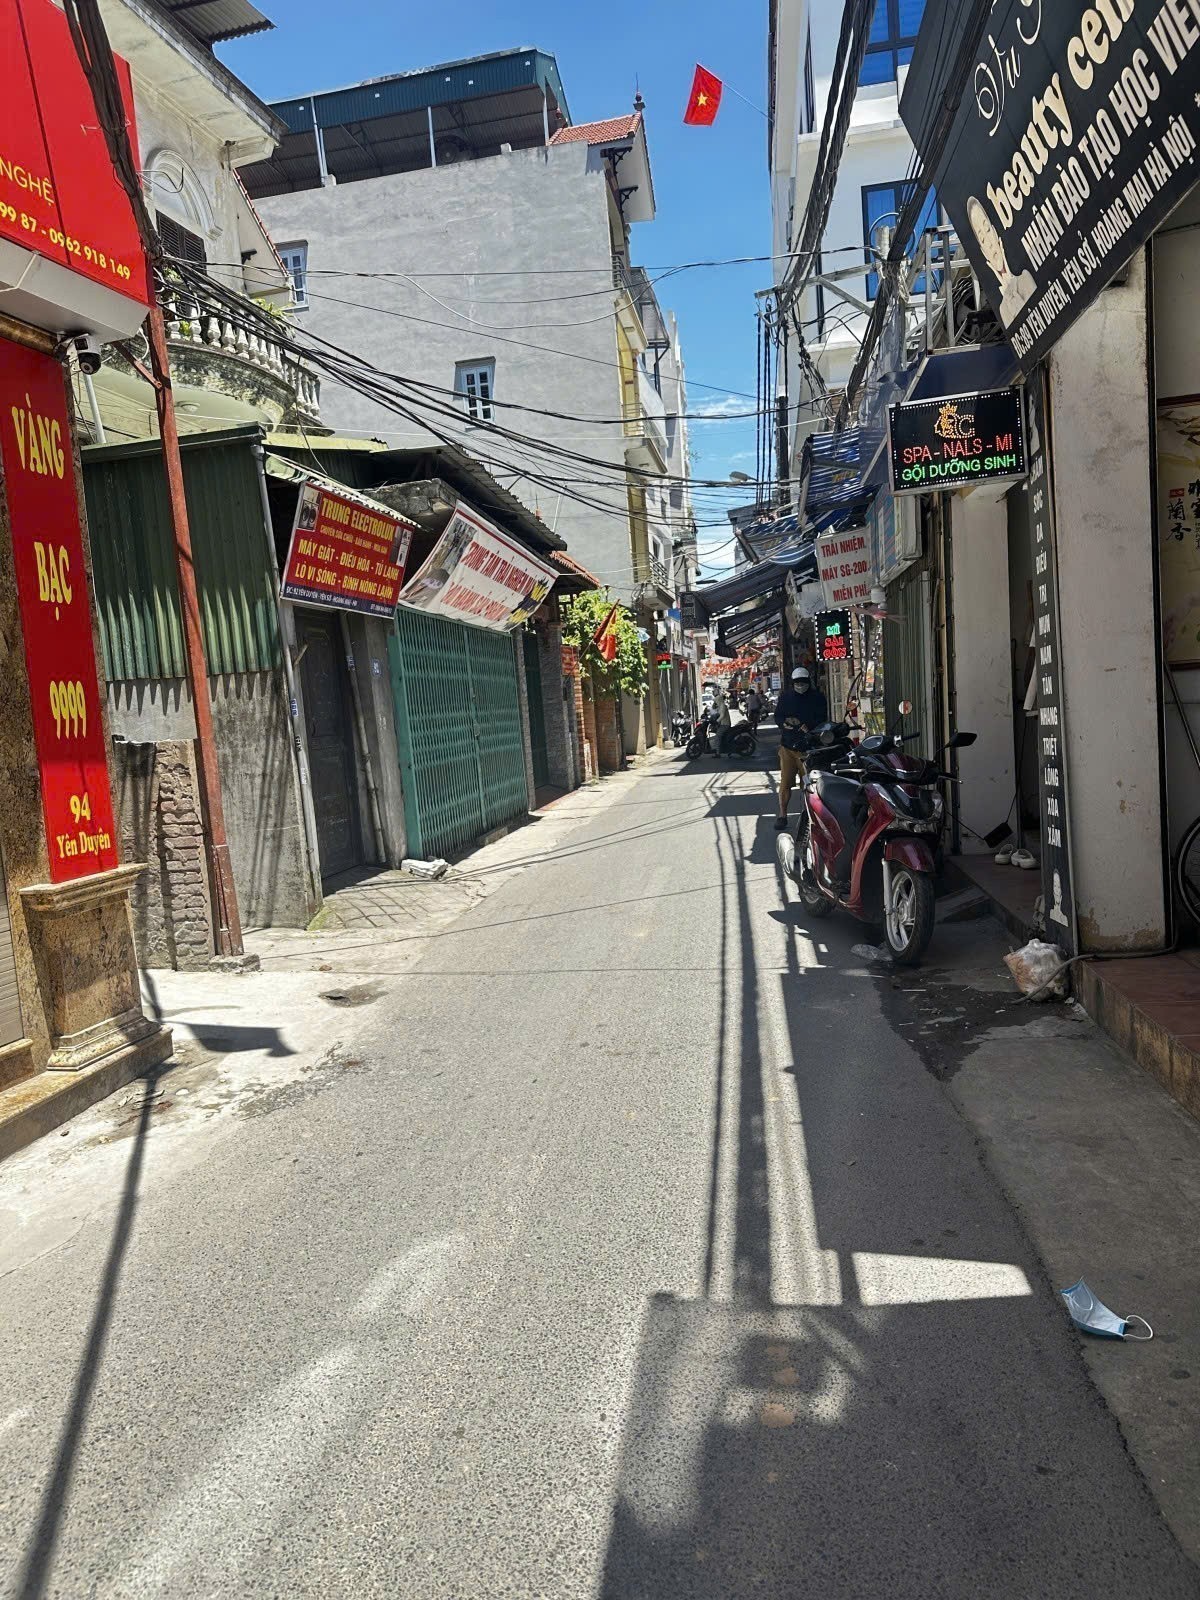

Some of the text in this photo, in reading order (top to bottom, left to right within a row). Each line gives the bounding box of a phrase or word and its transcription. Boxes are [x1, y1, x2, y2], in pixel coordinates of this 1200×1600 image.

[986, 72, 1073, 230] beauty
[1021, 197, 1065, 273] NHẬN
[1051, 156, 1091, 226] ĐÀO
[1078, 108, 1121, 182] TẠO
[1108, 48, 1161, 137] HỌC
[1026, 307, 1047, 340] YÊN
[1061, 257, 1086, 295] YÊN
[1091, 197, 1133, 258] HOÀNG
[1122, 168, 1154, 219] MAI
[1143, 141, 1173, 191] HÀ
[1161, 113, 1197, 170] NỘI
[21, 213, 37, 233] 87
[49, 227, 82, 257] 0962
[84, 245, 107, 269] 918
[110, 258, 131, 280] 149
[12, 392, 65, 480] VÀNG
[903, 446, 933, 464] SPA
[943, 438, 983, 459] NALS
[995, 434, 1013, 452] MI
[901, 454, 1017, 482] GỘI DƯỠNG SINH
[321, 498, 351, 527] TRUNG
[298, 539, 318, 557] MÁY
[318, 545, 336, 564] GIẶT
[839, 535, 866, 554] NHIỆM
[34, 541, 72, 621] BẠC
[316, 566, 337, 586] SÓNG
[822, 565, 839, 581] MÁY
[833, 584, 853, 602] MIỄN
[49, 680, 87, 740] 9999
[1040, 706, 1058, 726] NHANG
[69, 791, 92, 824] 94
[56, 831, 78, 859] Yên
[78, 827, 111, 857] Duyên
